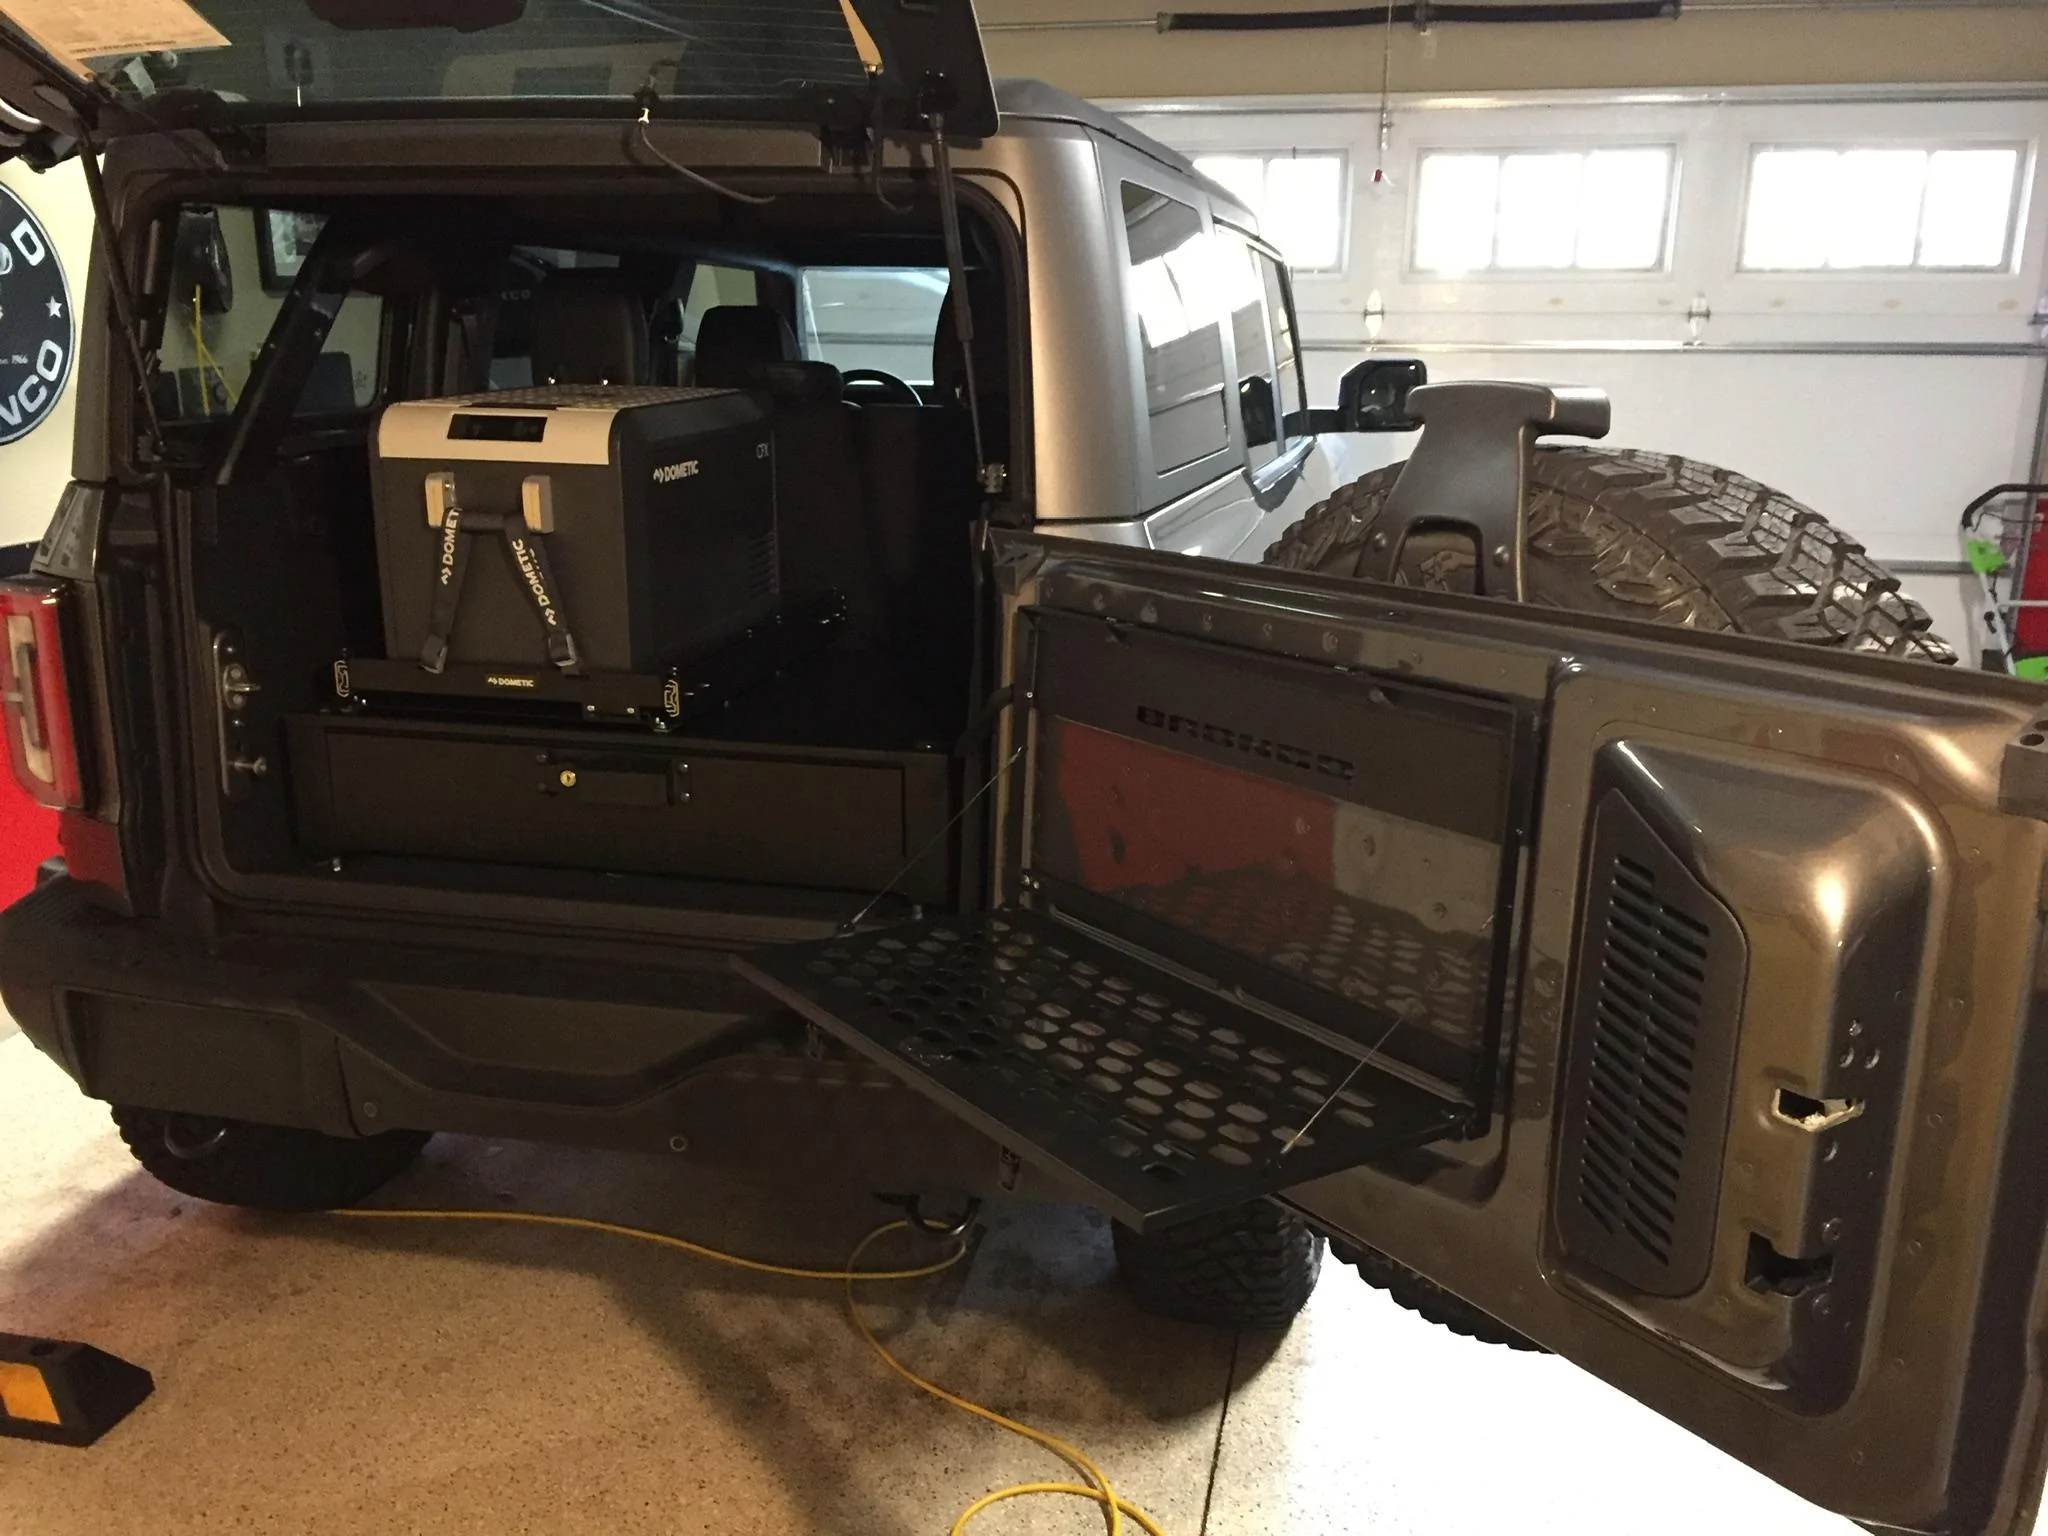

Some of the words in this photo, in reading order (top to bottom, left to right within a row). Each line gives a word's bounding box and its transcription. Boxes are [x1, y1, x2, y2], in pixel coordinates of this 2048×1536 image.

[664, 460, 699, 481] DOMETIC
[512, 539, 550, 607] DOMETIC
[498, 677, 534, 687] DOMETIC
[1136, 706, 1354, 779] BRONCO
